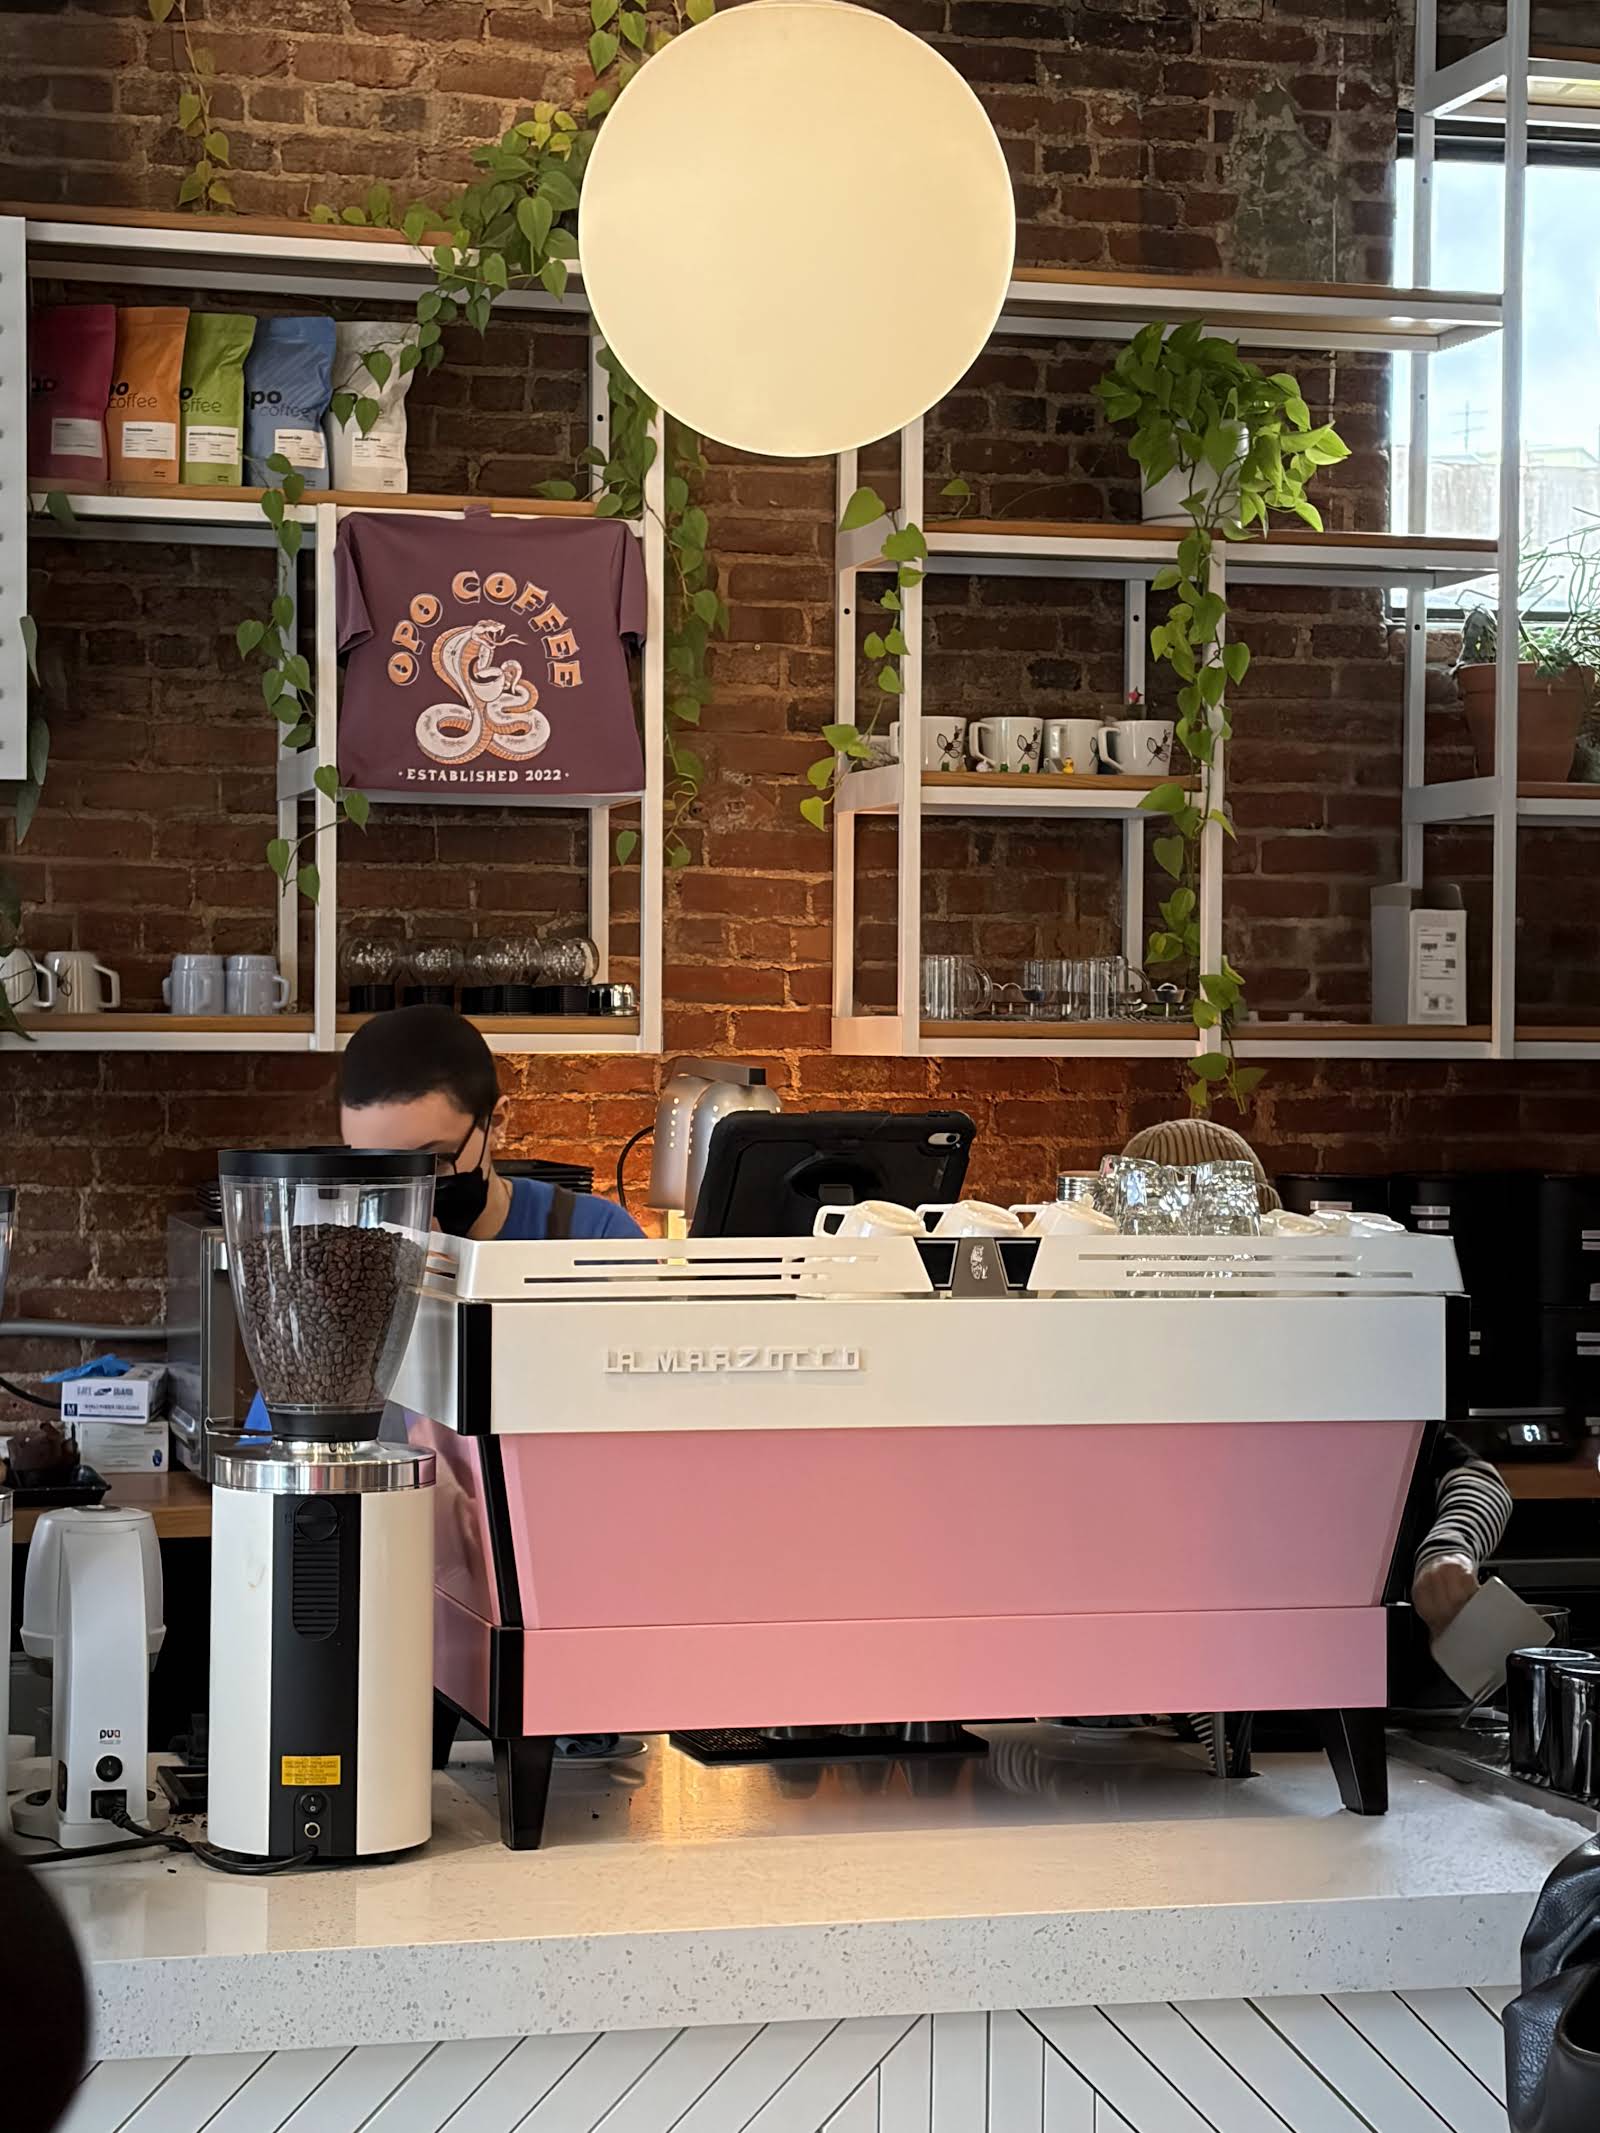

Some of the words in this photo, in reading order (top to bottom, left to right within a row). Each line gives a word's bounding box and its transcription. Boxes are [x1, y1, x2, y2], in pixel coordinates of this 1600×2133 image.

[181, 397, 222, 413] offee
[387, 593, 443, 686] OPO
[452, 570, 583, 688] COFFEE
[406, 768, 519, 783] ESTABLISHED
[525, 768, 562, 782] 2022
